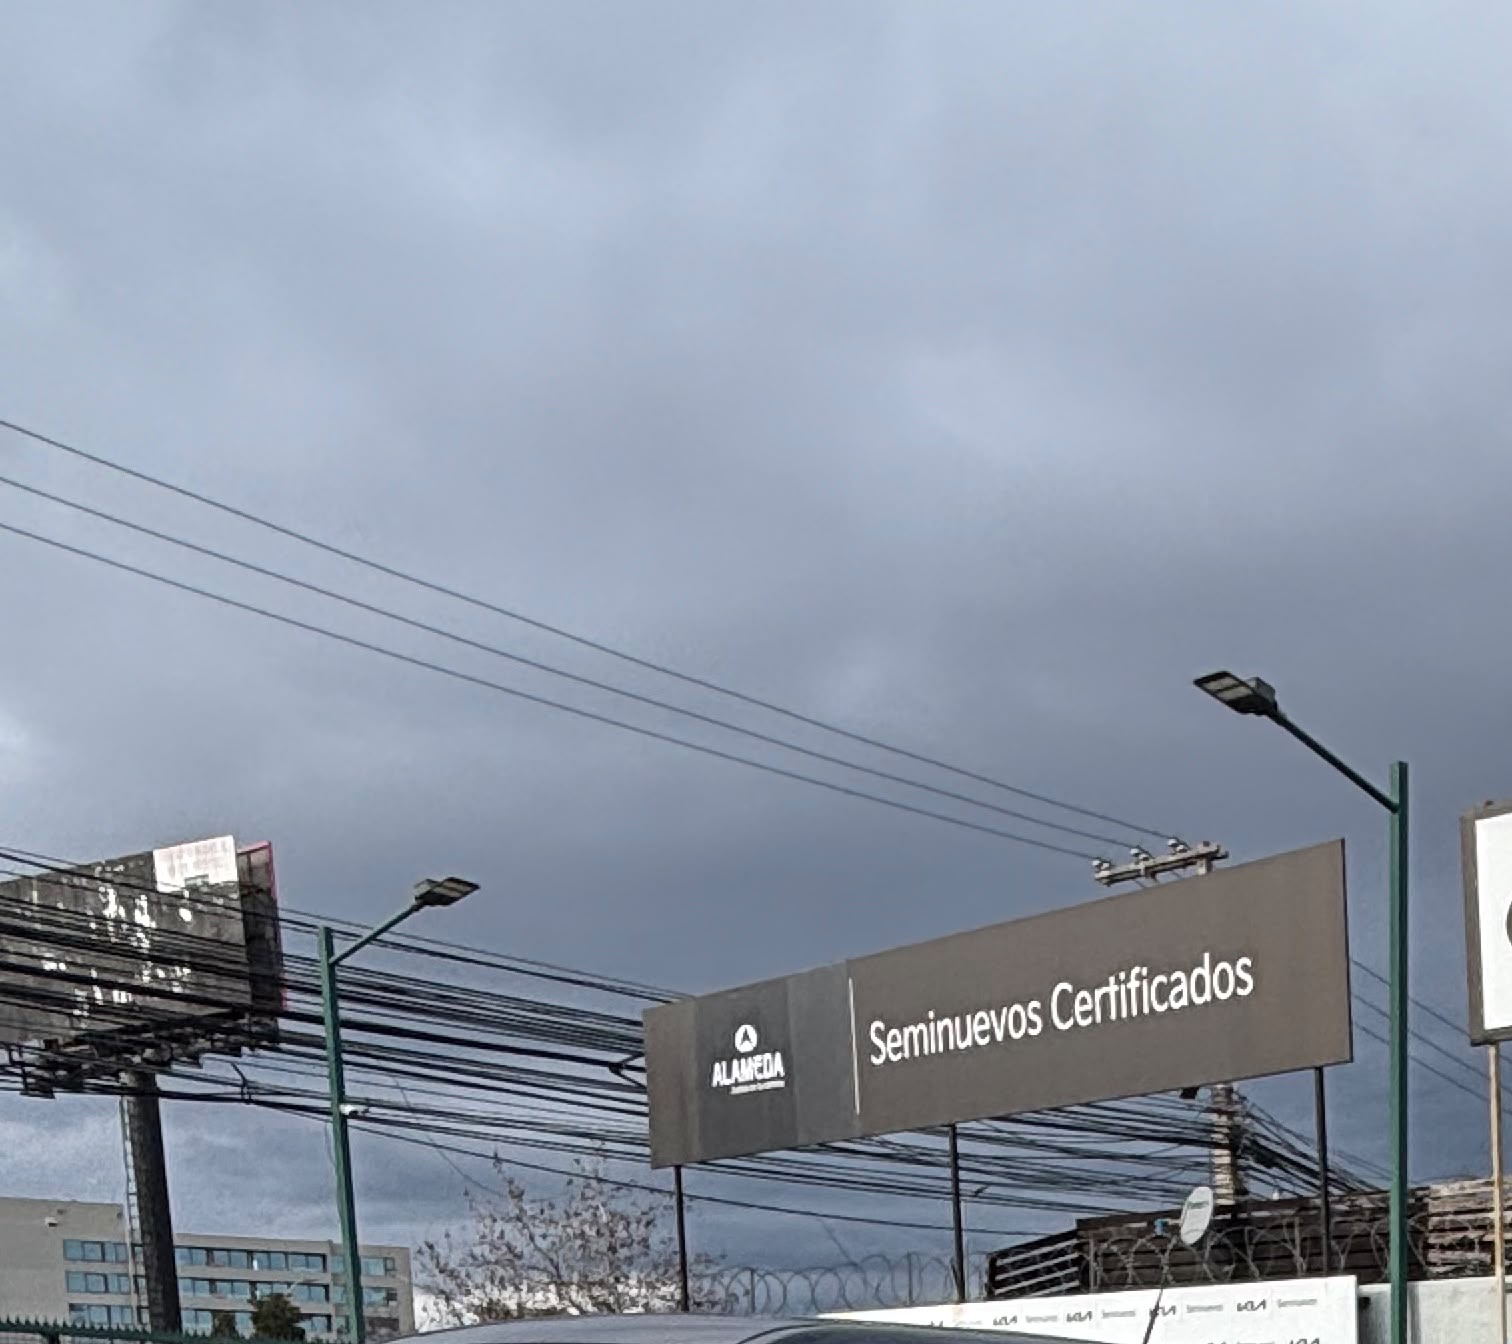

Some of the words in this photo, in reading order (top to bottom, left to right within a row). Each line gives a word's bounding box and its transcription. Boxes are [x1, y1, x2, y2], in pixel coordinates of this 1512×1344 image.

[869, 1000, 1043, 1066] Seminuevos
[1050, 951, 1254, 1031] Certificados
[711, 1052, 786, 1088] ALAMEDA
[1236, 1299, 1266, 1312] KIA
